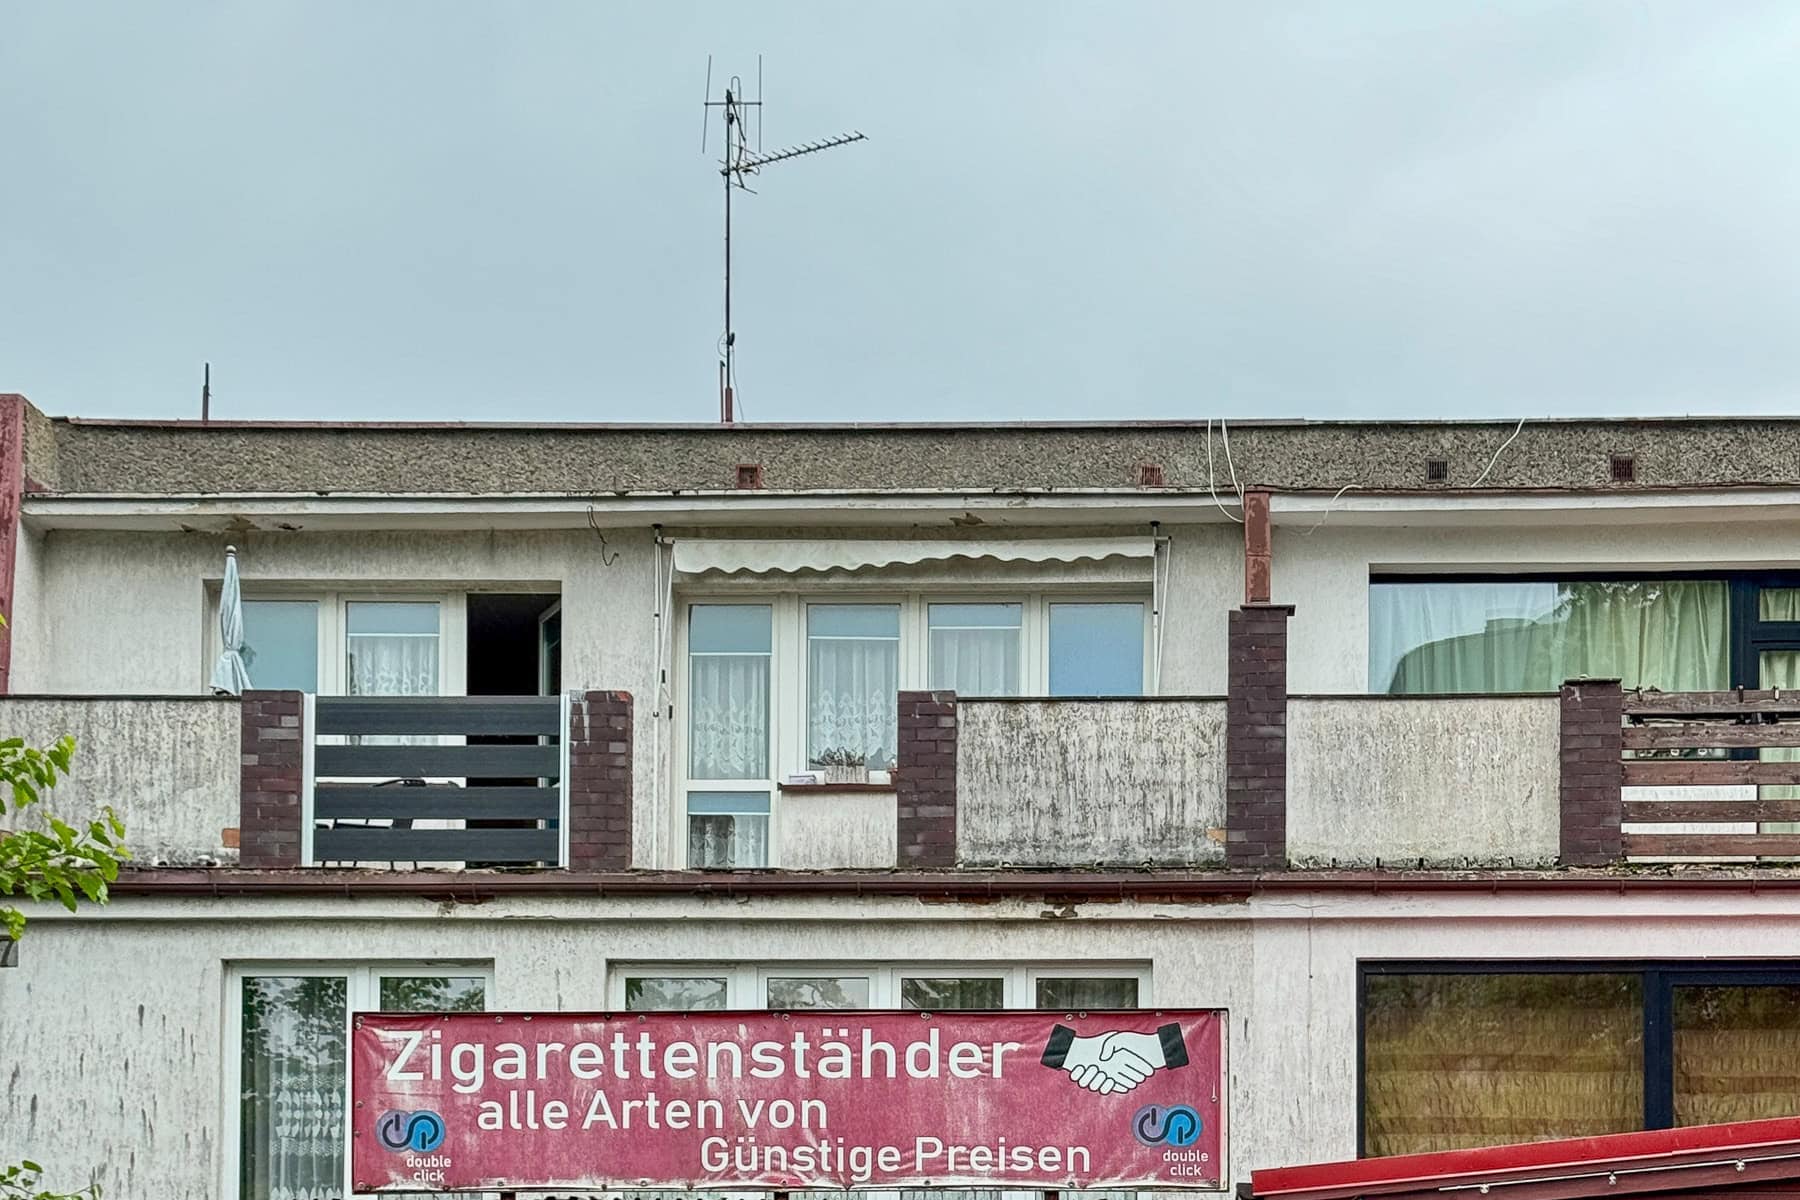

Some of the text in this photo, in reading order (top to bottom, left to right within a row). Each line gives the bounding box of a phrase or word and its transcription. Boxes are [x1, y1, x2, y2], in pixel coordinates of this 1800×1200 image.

[386, 1028, 1020, 1094] Zigarettenstähder
[477, 1090, 828, 1130] alle Arten von
[406, 1154, 452, 1168] double
[700, 1136, 1091, 1181] Günstige Preisen
[1162, 1149, 1209, 1162] double
[413, 1169, 445, 1182] click
[1170, 1163, 1202, 1176] click
